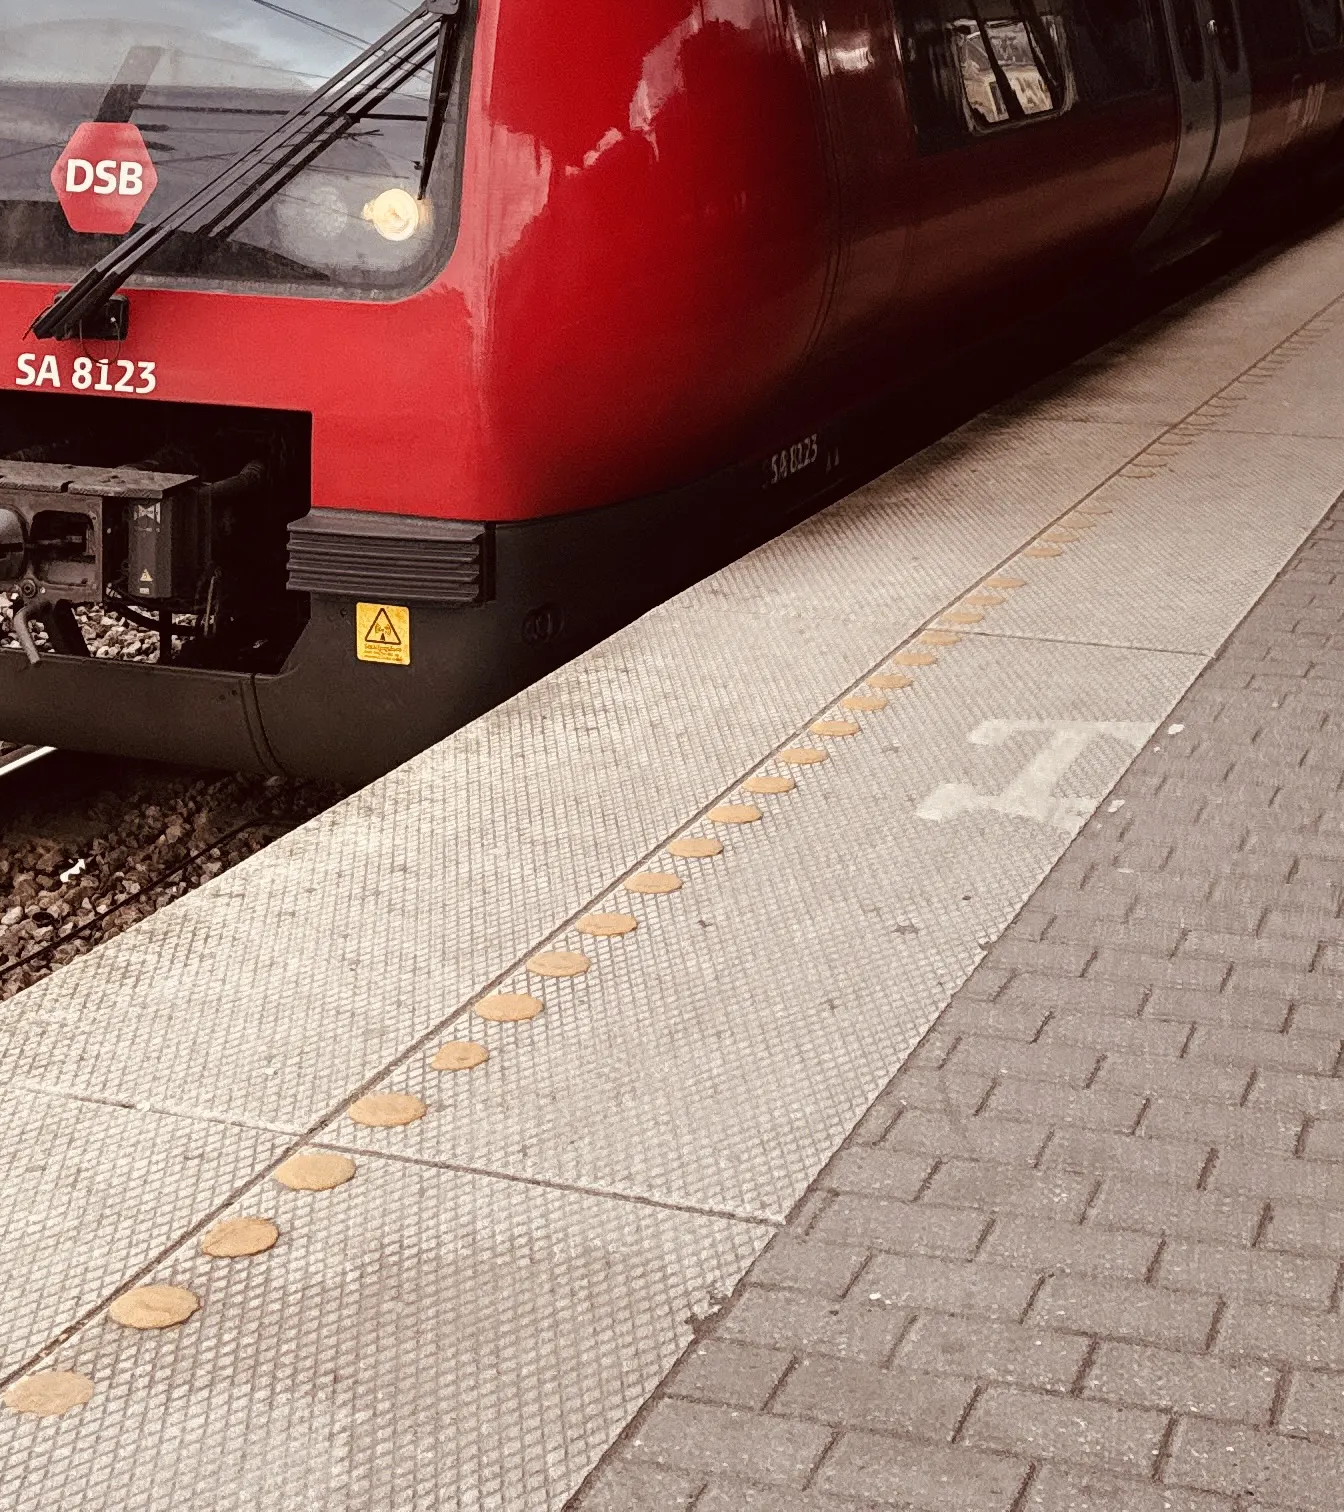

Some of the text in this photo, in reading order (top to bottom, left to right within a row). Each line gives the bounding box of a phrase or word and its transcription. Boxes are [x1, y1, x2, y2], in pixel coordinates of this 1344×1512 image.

[64, 158, 143, 196] DSB
[14, 352, 157, 395] SA 8123
